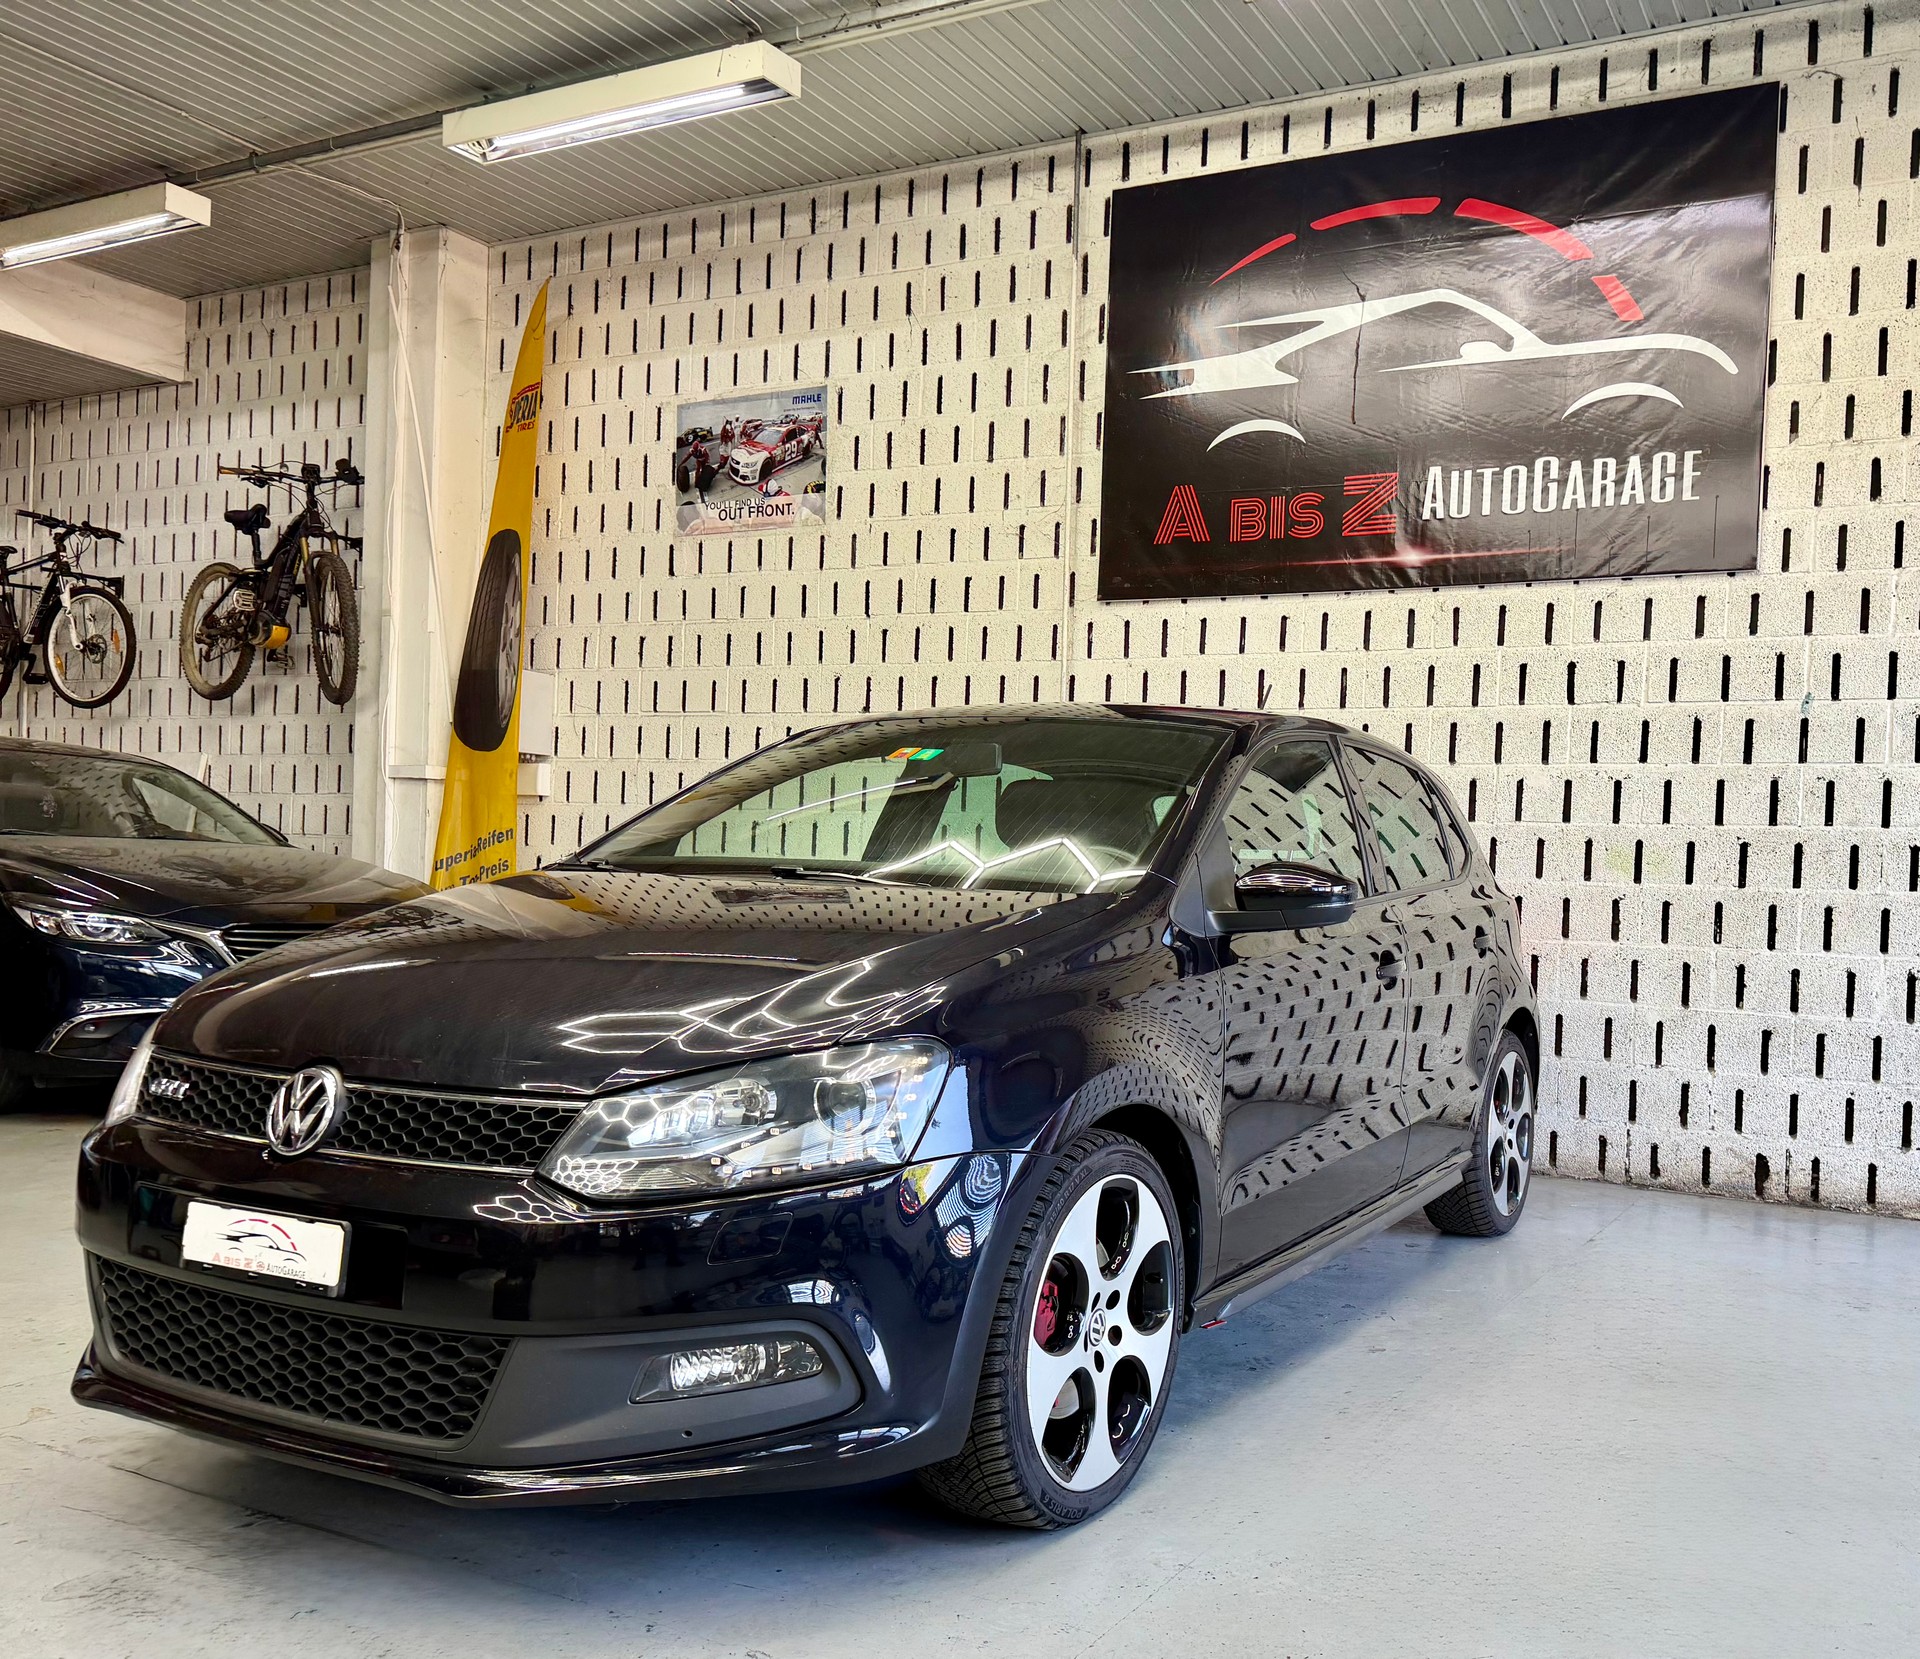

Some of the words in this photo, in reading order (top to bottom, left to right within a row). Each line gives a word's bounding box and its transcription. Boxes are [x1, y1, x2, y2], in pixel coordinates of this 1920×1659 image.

[792, 393, 822, 405] MAHLE
[785, 440, 797, 461] 29
[705, 500, 733, 511] YOU'LL
[735, 498, 752, 509] FIND
[755, 497, 766, 506] US
[718, 507, 745, 521] OUT
[748, 503, 795, 519] FRONT.
[1154, 484, 1210, 545] A
[1342, 472, 1398, 537] Z
[211, 1252, 221, 1263] A
[1049, 1500, 1083, 1518] POLARIS
